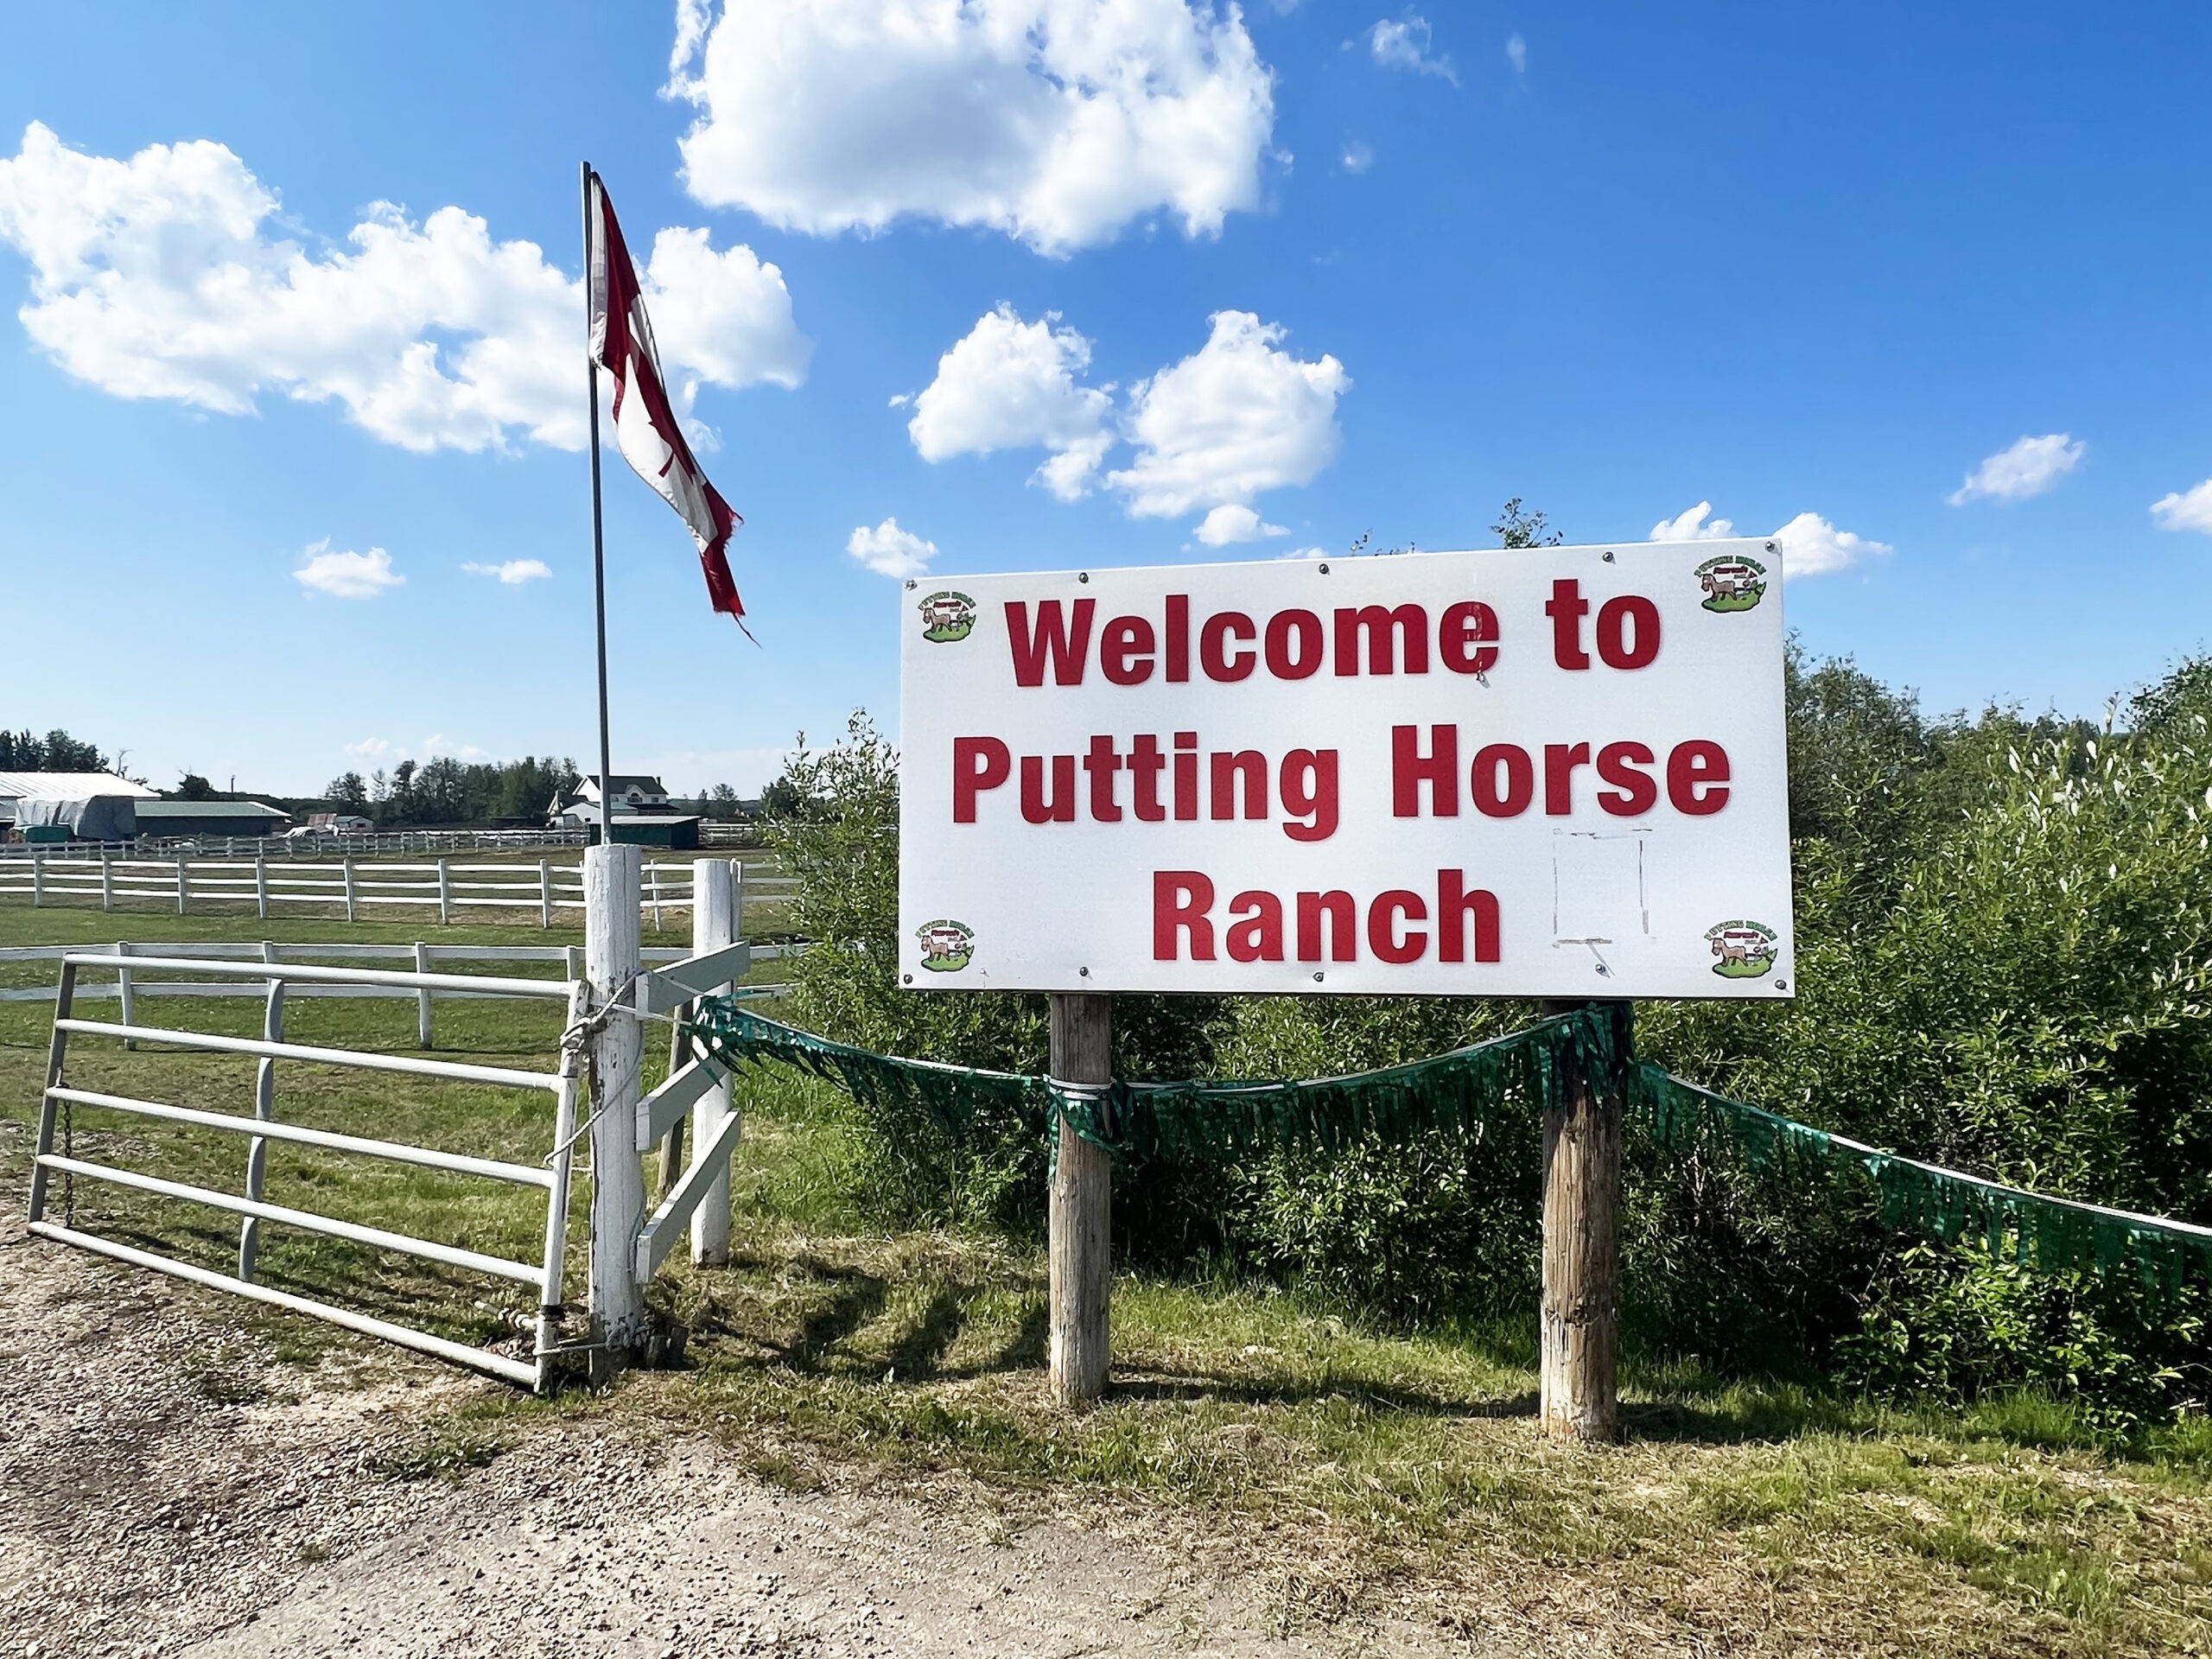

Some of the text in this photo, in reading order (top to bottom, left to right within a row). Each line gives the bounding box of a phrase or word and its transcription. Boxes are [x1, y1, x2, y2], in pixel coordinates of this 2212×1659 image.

[1006, 580, 1660, 687] Welcome to
[954, 725, 1730, 842] Putting Horse
[1154, 869, 1500, 963] Ranch
